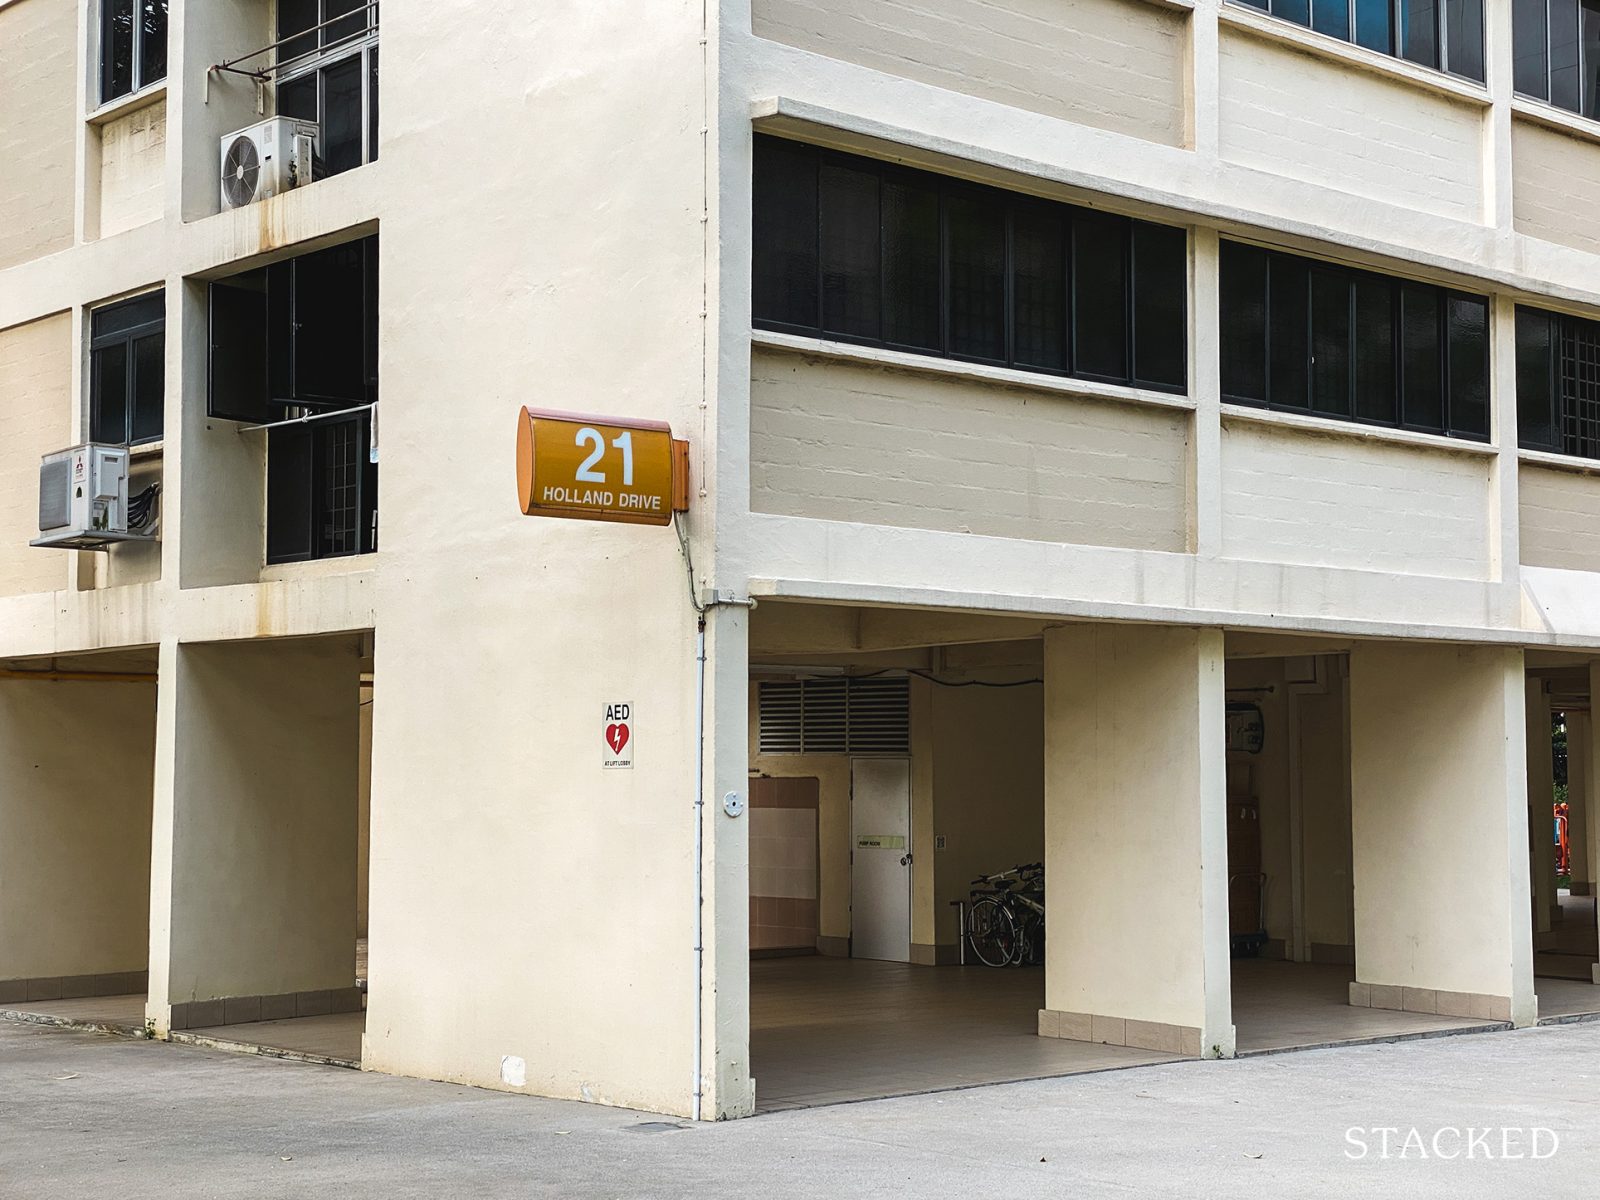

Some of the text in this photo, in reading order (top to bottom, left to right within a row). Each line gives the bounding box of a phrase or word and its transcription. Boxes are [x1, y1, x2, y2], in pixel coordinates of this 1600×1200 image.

[575, 427, 633, 486] 21
[543, 486, 661, 510] HOLLAND DRIVE
[605, 704, 630, 721] AED
